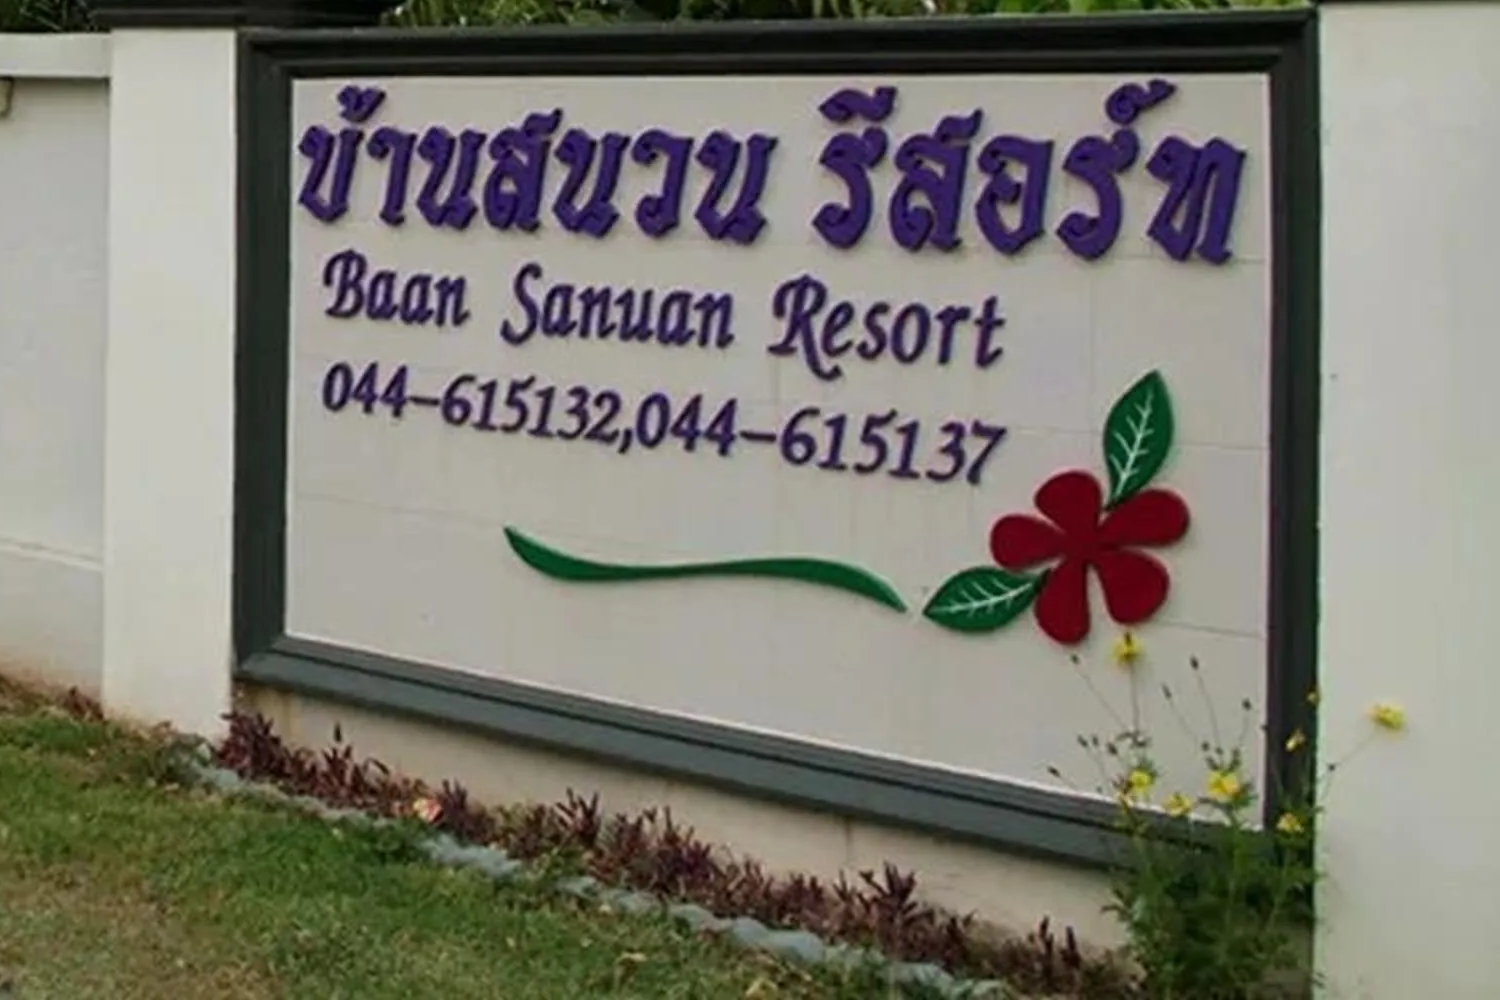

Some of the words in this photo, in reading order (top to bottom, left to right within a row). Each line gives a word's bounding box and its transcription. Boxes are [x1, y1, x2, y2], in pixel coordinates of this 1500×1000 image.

[298, 85, 777, 245] บ้านสนวน
[812, 79, 1247, 265] รีสอร์ท
[323, 249, 470, 328] Baan
[500, 262, 734, 349] Sanuan
[767, 275, 1006, 381] Resort
